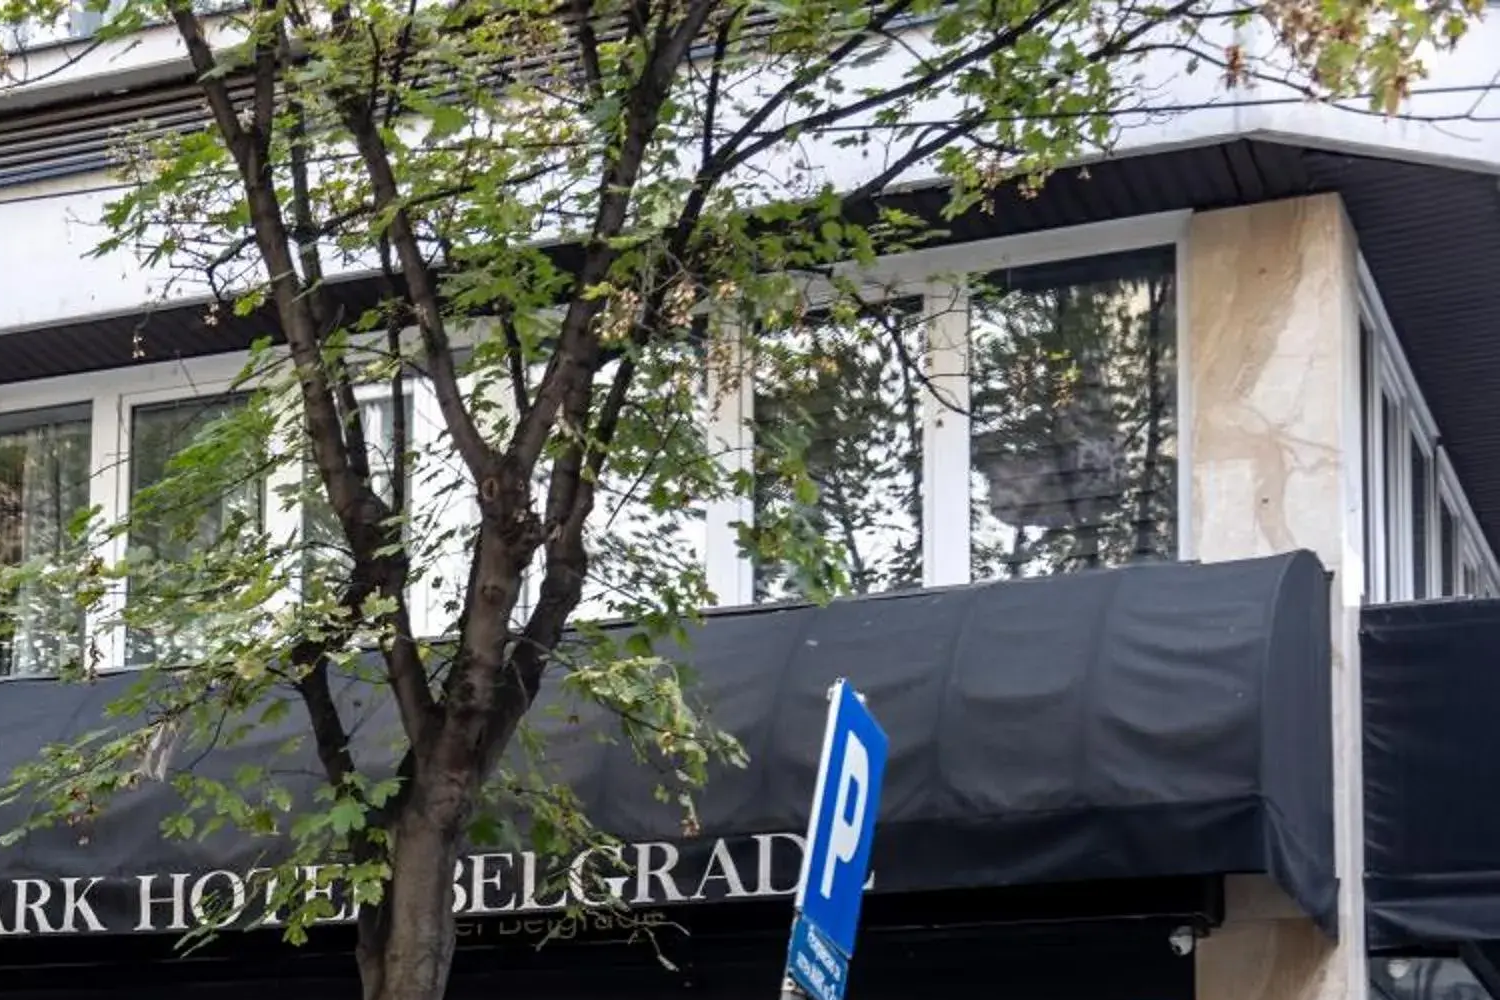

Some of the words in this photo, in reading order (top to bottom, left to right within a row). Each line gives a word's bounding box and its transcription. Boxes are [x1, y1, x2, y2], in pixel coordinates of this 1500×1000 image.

[133, 862, 361, 932] HOTE
[451, 832, 874, 914] ELGRAD
[820, 730, 869, 900] P
